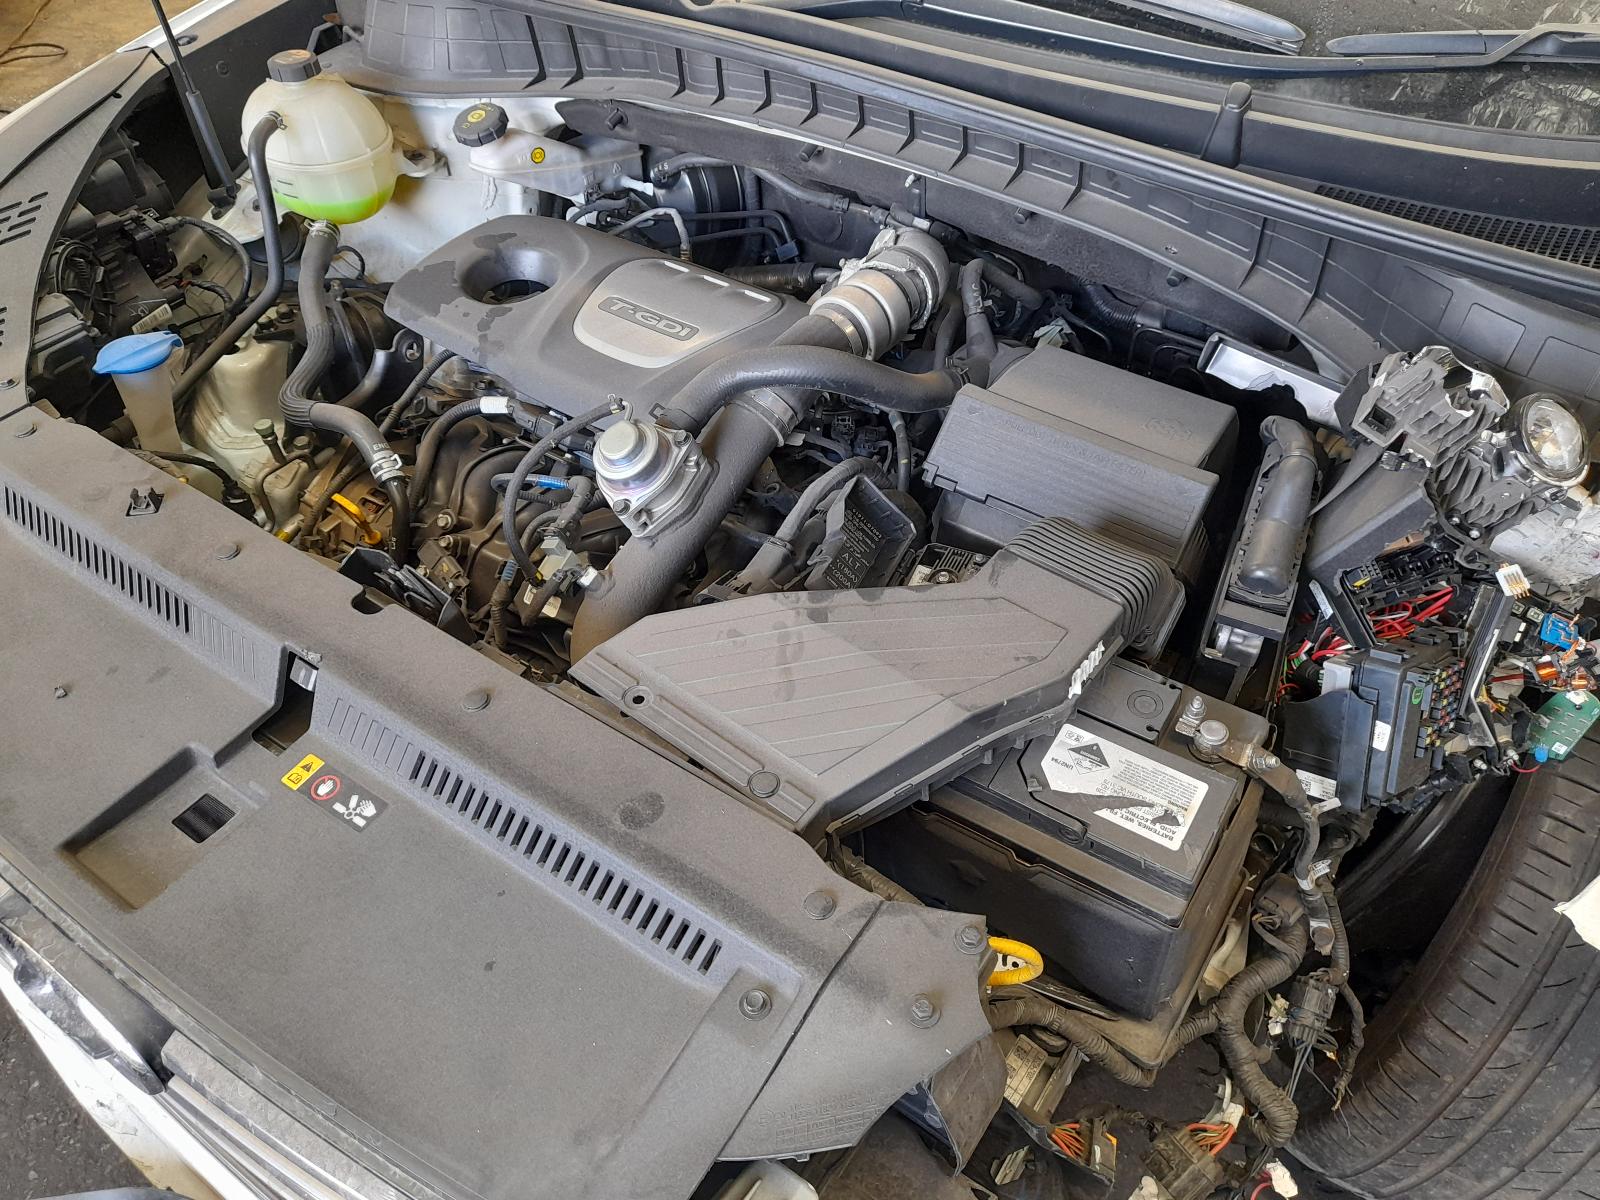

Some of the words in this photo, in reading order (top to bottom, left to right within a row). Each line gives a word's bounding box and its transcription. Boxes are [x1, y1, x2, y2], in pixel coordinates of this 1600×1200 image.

[841, 552, 861, 570] ALT
[1051, 756, 1074, 770] UN2794
[1118, 811, 1135, 822] WET,
[1134, 819, 1174, 841] BATTERIES,
